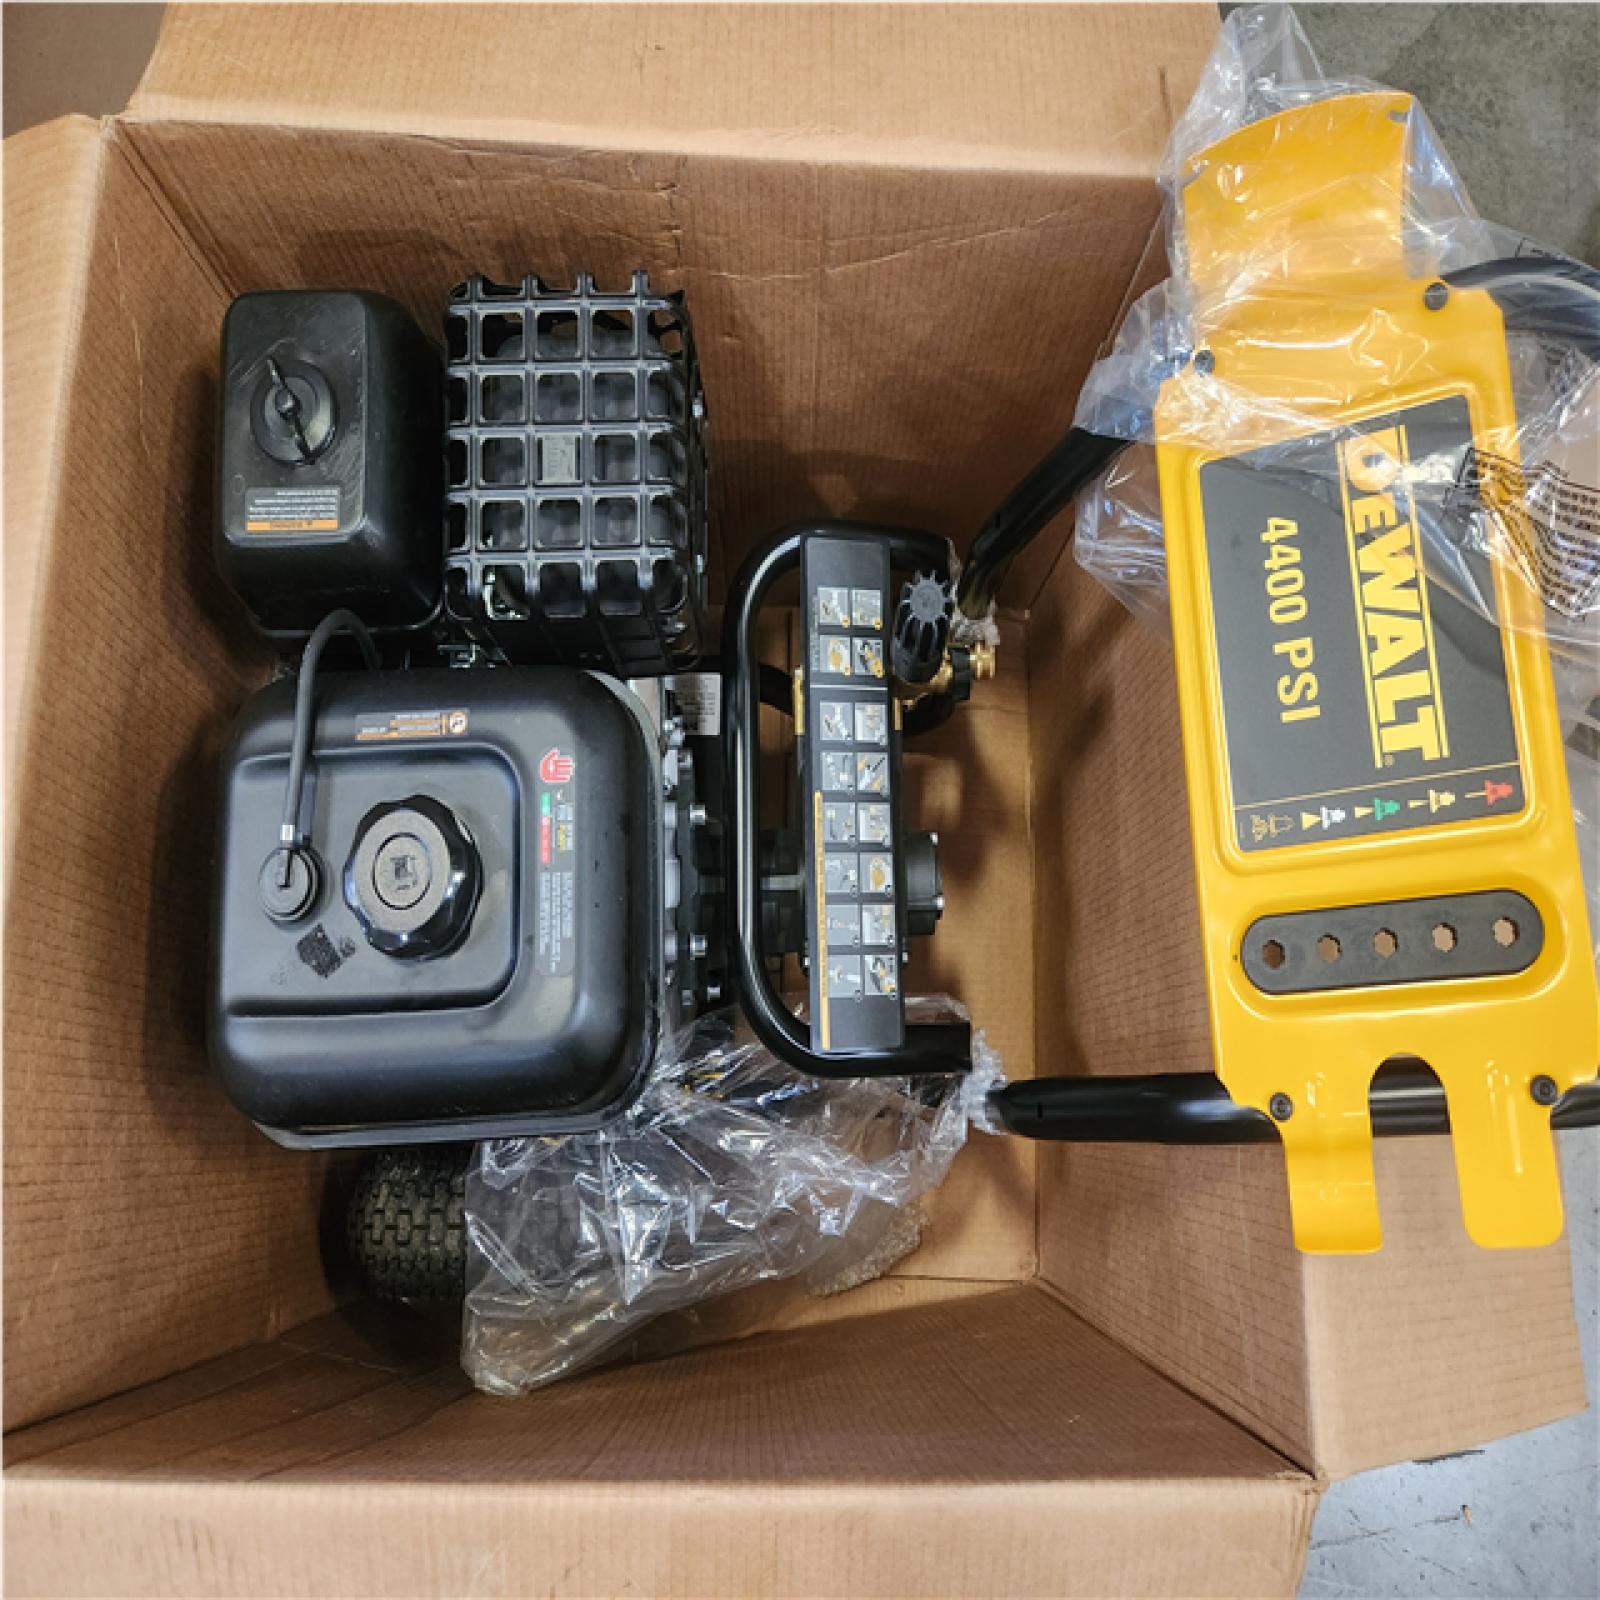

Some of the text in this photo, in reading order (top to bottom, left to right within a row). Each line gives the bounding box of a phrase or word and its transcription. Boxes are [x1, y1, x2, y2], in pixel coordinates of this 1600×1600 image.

[1259, 516, 1322, 723] 4400 PSI
[1344, 426, 1443, 762] DEWALT
